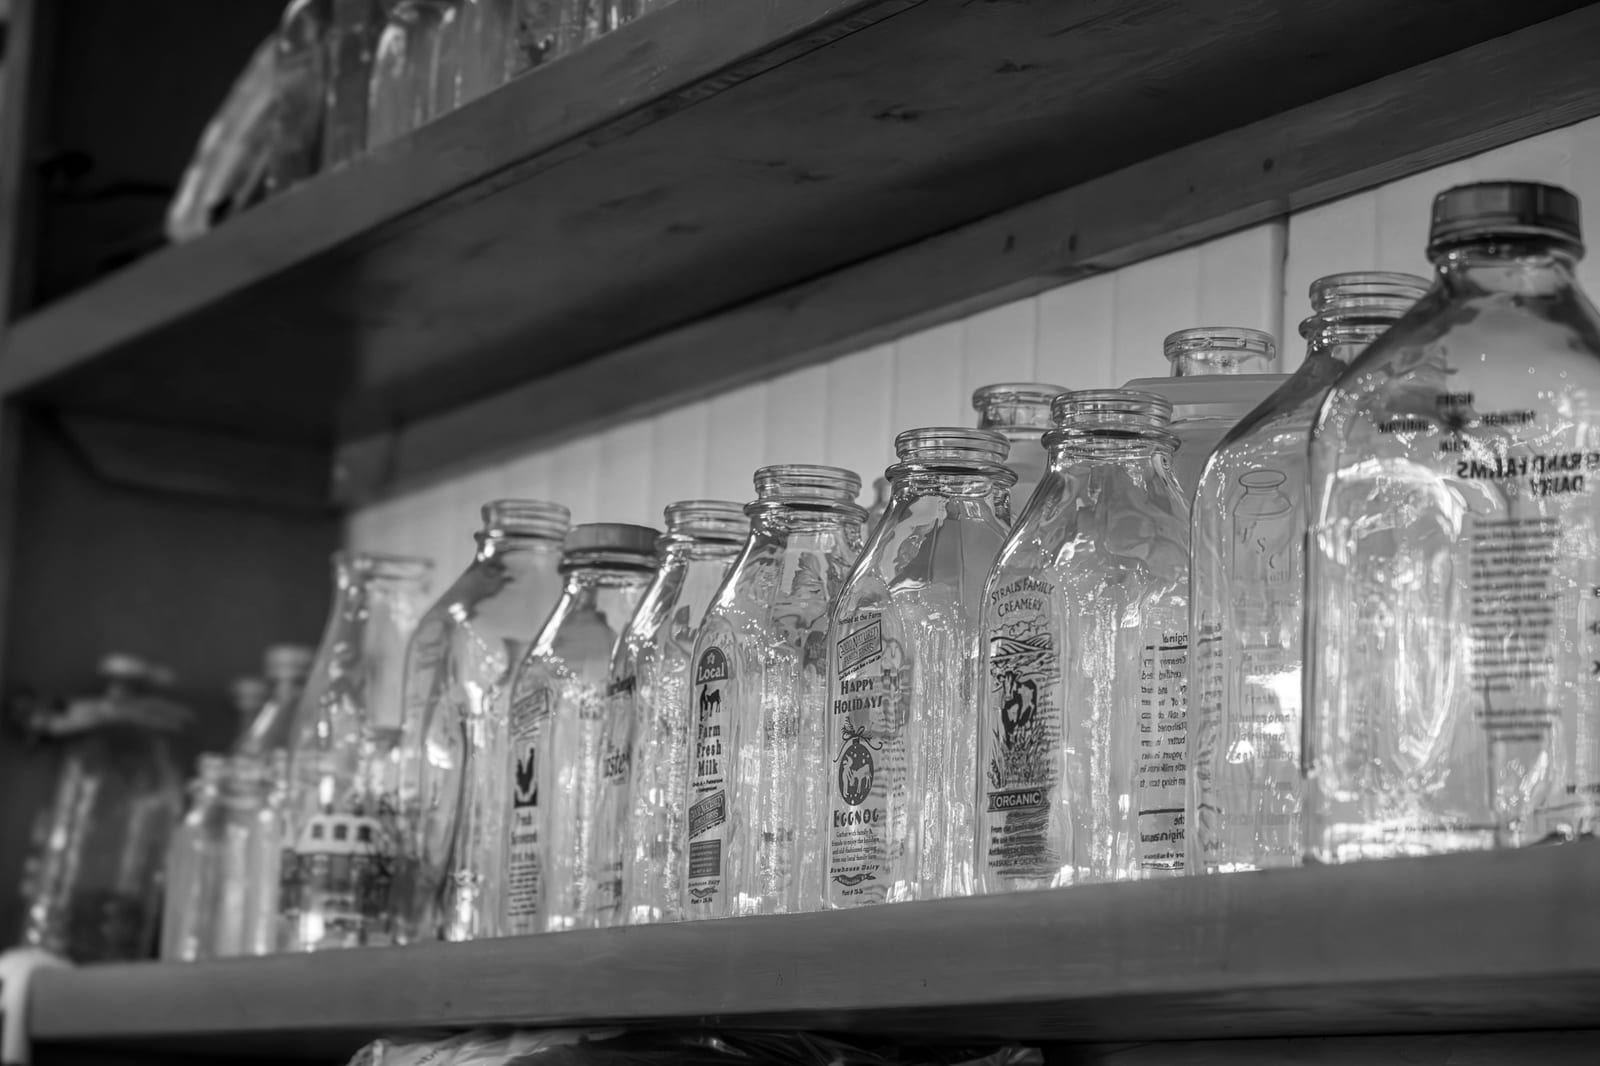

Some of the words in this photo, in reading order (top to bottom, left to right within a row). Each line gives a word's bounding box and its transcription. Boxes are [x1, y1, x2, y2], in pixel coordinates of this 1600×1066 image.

[991, 580, 1021, 605] STRAUS
[1023, 578, 1055, 595] FAMILY
[997, 597, 1043, 617] CREAMERY
[698, 662, 725, 681] Local
[841, 679, 874, 695] HAPPY
[834, 696, 882, 715] HOLIDAYS
[698, 724, 720, 740] Farm
[696, 740, 722, 758] Fresh
[698, 759, 718, 777] Milk
[996, 792, 1040, 808] ORGANIC
[834, 808, 880, 828] EGGNOG
